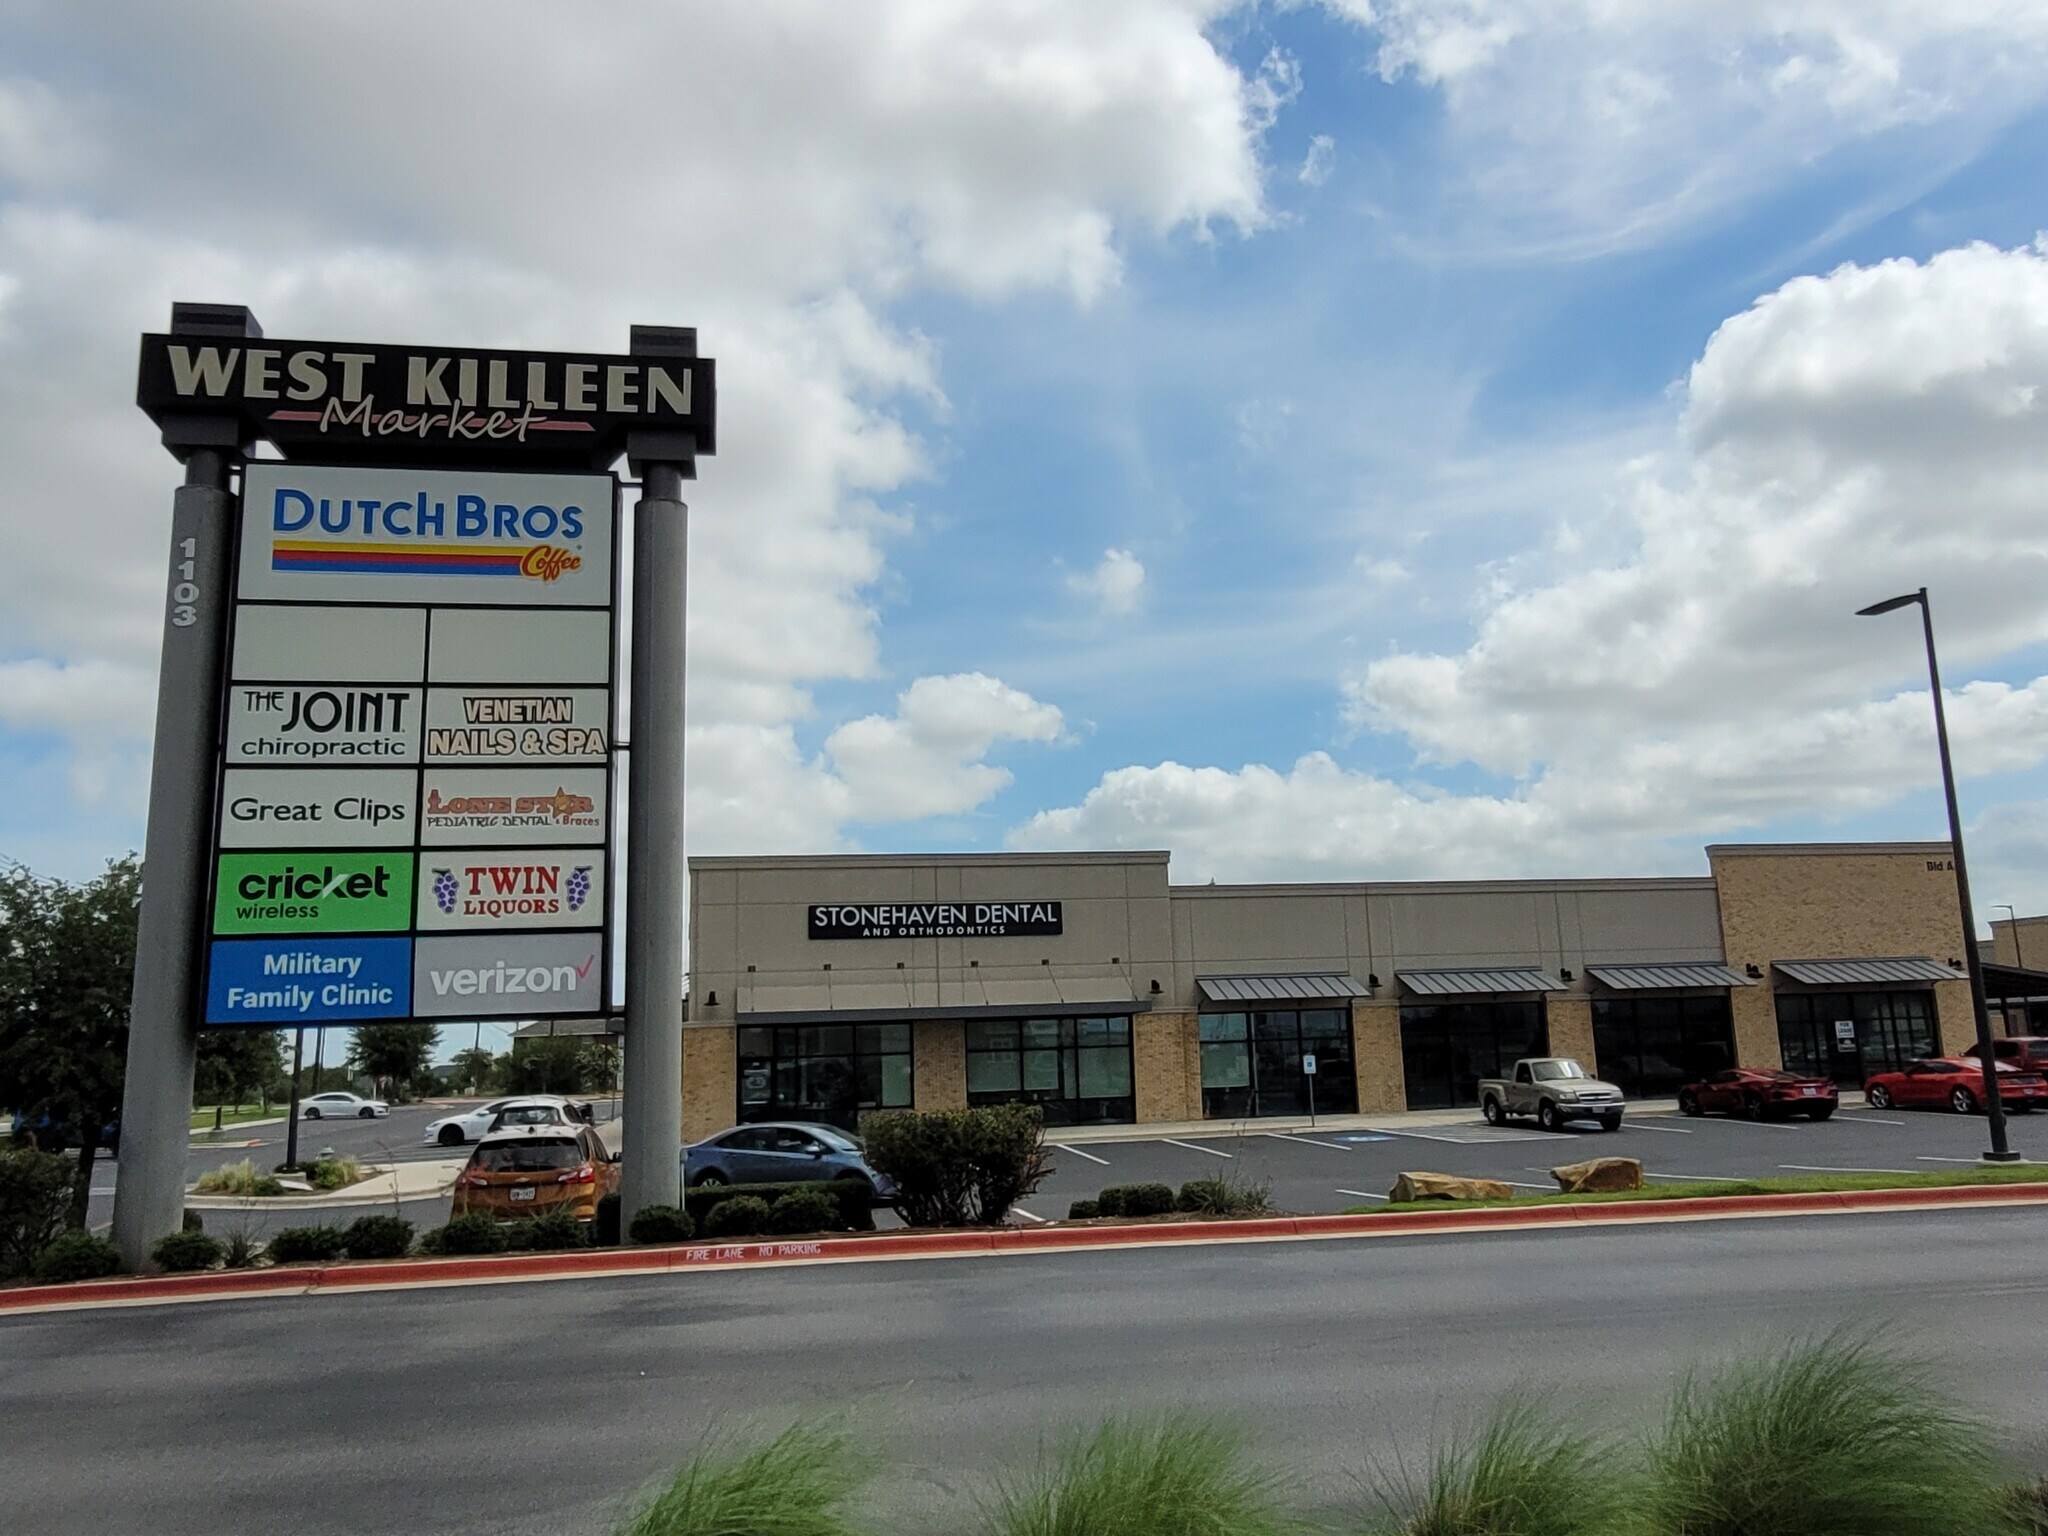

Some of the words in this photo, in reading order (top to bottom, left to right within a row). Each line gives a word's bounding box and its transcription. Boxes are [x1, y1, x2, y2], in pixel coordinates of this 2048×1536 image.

[167, 345, 376, 402] WEST
[407, 356, 692, 415] KILLEEN
[319, 393, 547, 442] Market
[456, 494, 584, 539] BROS
[521, 545, 582, 582] Coffee
[172, 538, 200, 627] 1103
[243, 691, 285, 712] THE
[281, 691, 411, 733] JOINT
[463, 697, 573, 723] VENETIAN
[241, 737, 406, 758] chiropractic
[429, 728, 515, 756] NAILS
[520, 728, 545, 756] &
[547, 728, 607, 756] SPA
[230, 797, 322, 821] Great
[334, 797, 405, 827] Clips
[427, 789, 511, 814] LONE
[427, 815, 498, 827] PEDIATRIC
[502, 815, 552, 827] DENTAL
[562, 815, 600, 827] Braces
[238, 865, 391, 901] cricket
[464, 866, 560, 895] TWIN
[236, 902, 319, 919] wireless
[463, 898, 560, 918] LIQUORS
[815, 905, 967, 927] STONEHAVEN
[975, 903, 1058, 924] DENTAL
[863, 927, 891, 937] AND
[899, 925, 1006, 936] ORTHODONTICS
[263, 952, 363, 978] Military
[430, 960, 577, 995] verizon
[227, 984, 315, 1012] Family
[321, 982, 394, 1007] Clinic
[686, 1250, 710, 1261] FIRE
[716, 1247, 745, 1260] LANE
[759, 1245, 774, 1257] NO
[778, 1243, 821, 1255] PARKING
